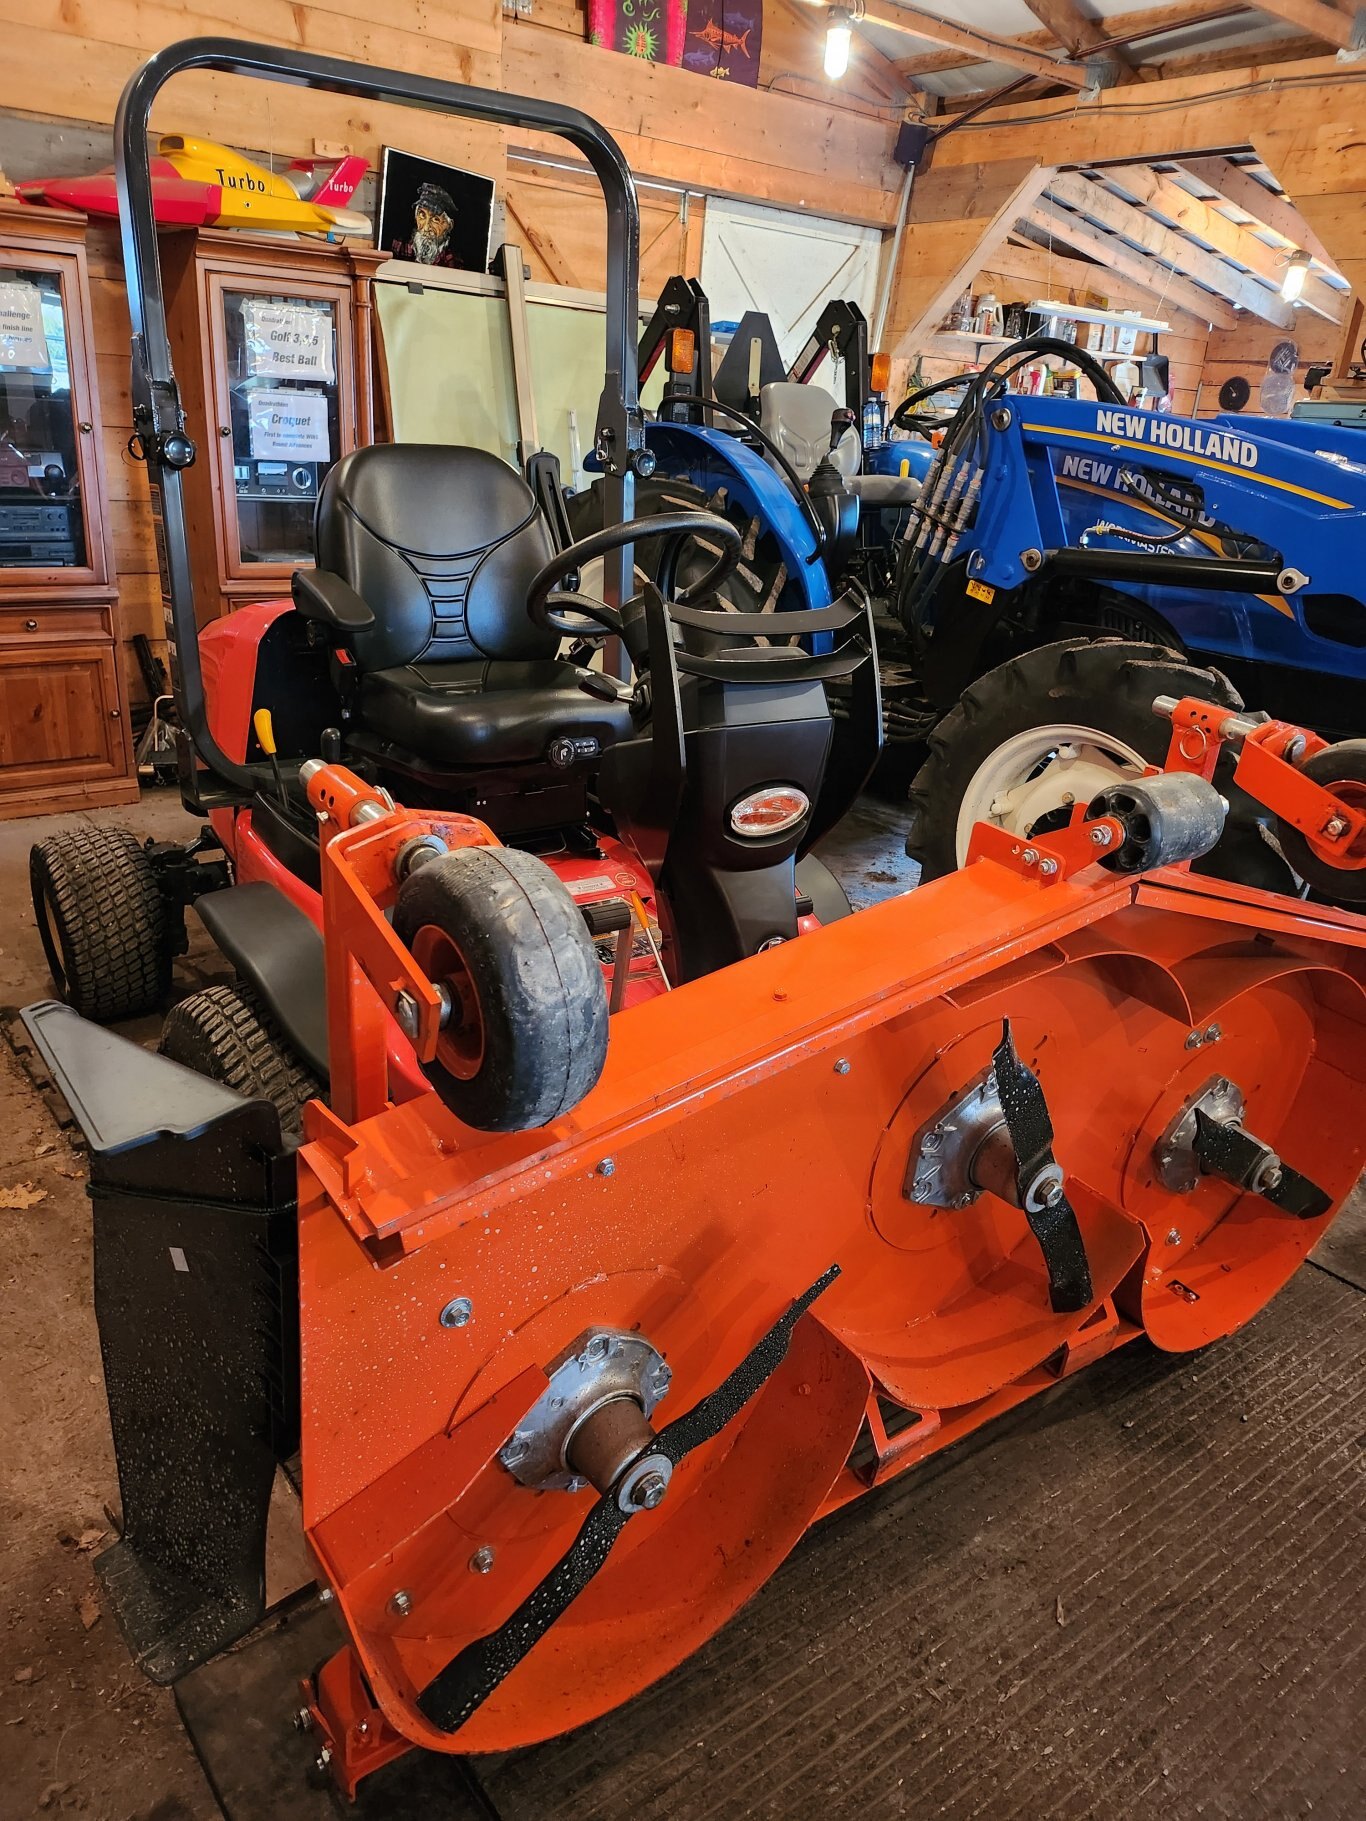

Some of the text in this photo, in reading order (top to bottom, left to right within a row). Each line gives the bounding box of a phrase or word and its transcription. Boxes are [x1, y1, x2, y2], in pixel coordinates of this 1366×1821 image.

[215, 169, 265, 192] Turbo
[328, 179, 354, 193] Turbo
[2, 323, 33, 333] finish line
[270, 330, 292, 343] Golf
[272, 351, 318, 367] Best Ball
[271, 413, 312, 428] Croquet
[1096, 409, 1259, 468] NEW HOLLAND
[1062, 455, 1113, 485] NEW
